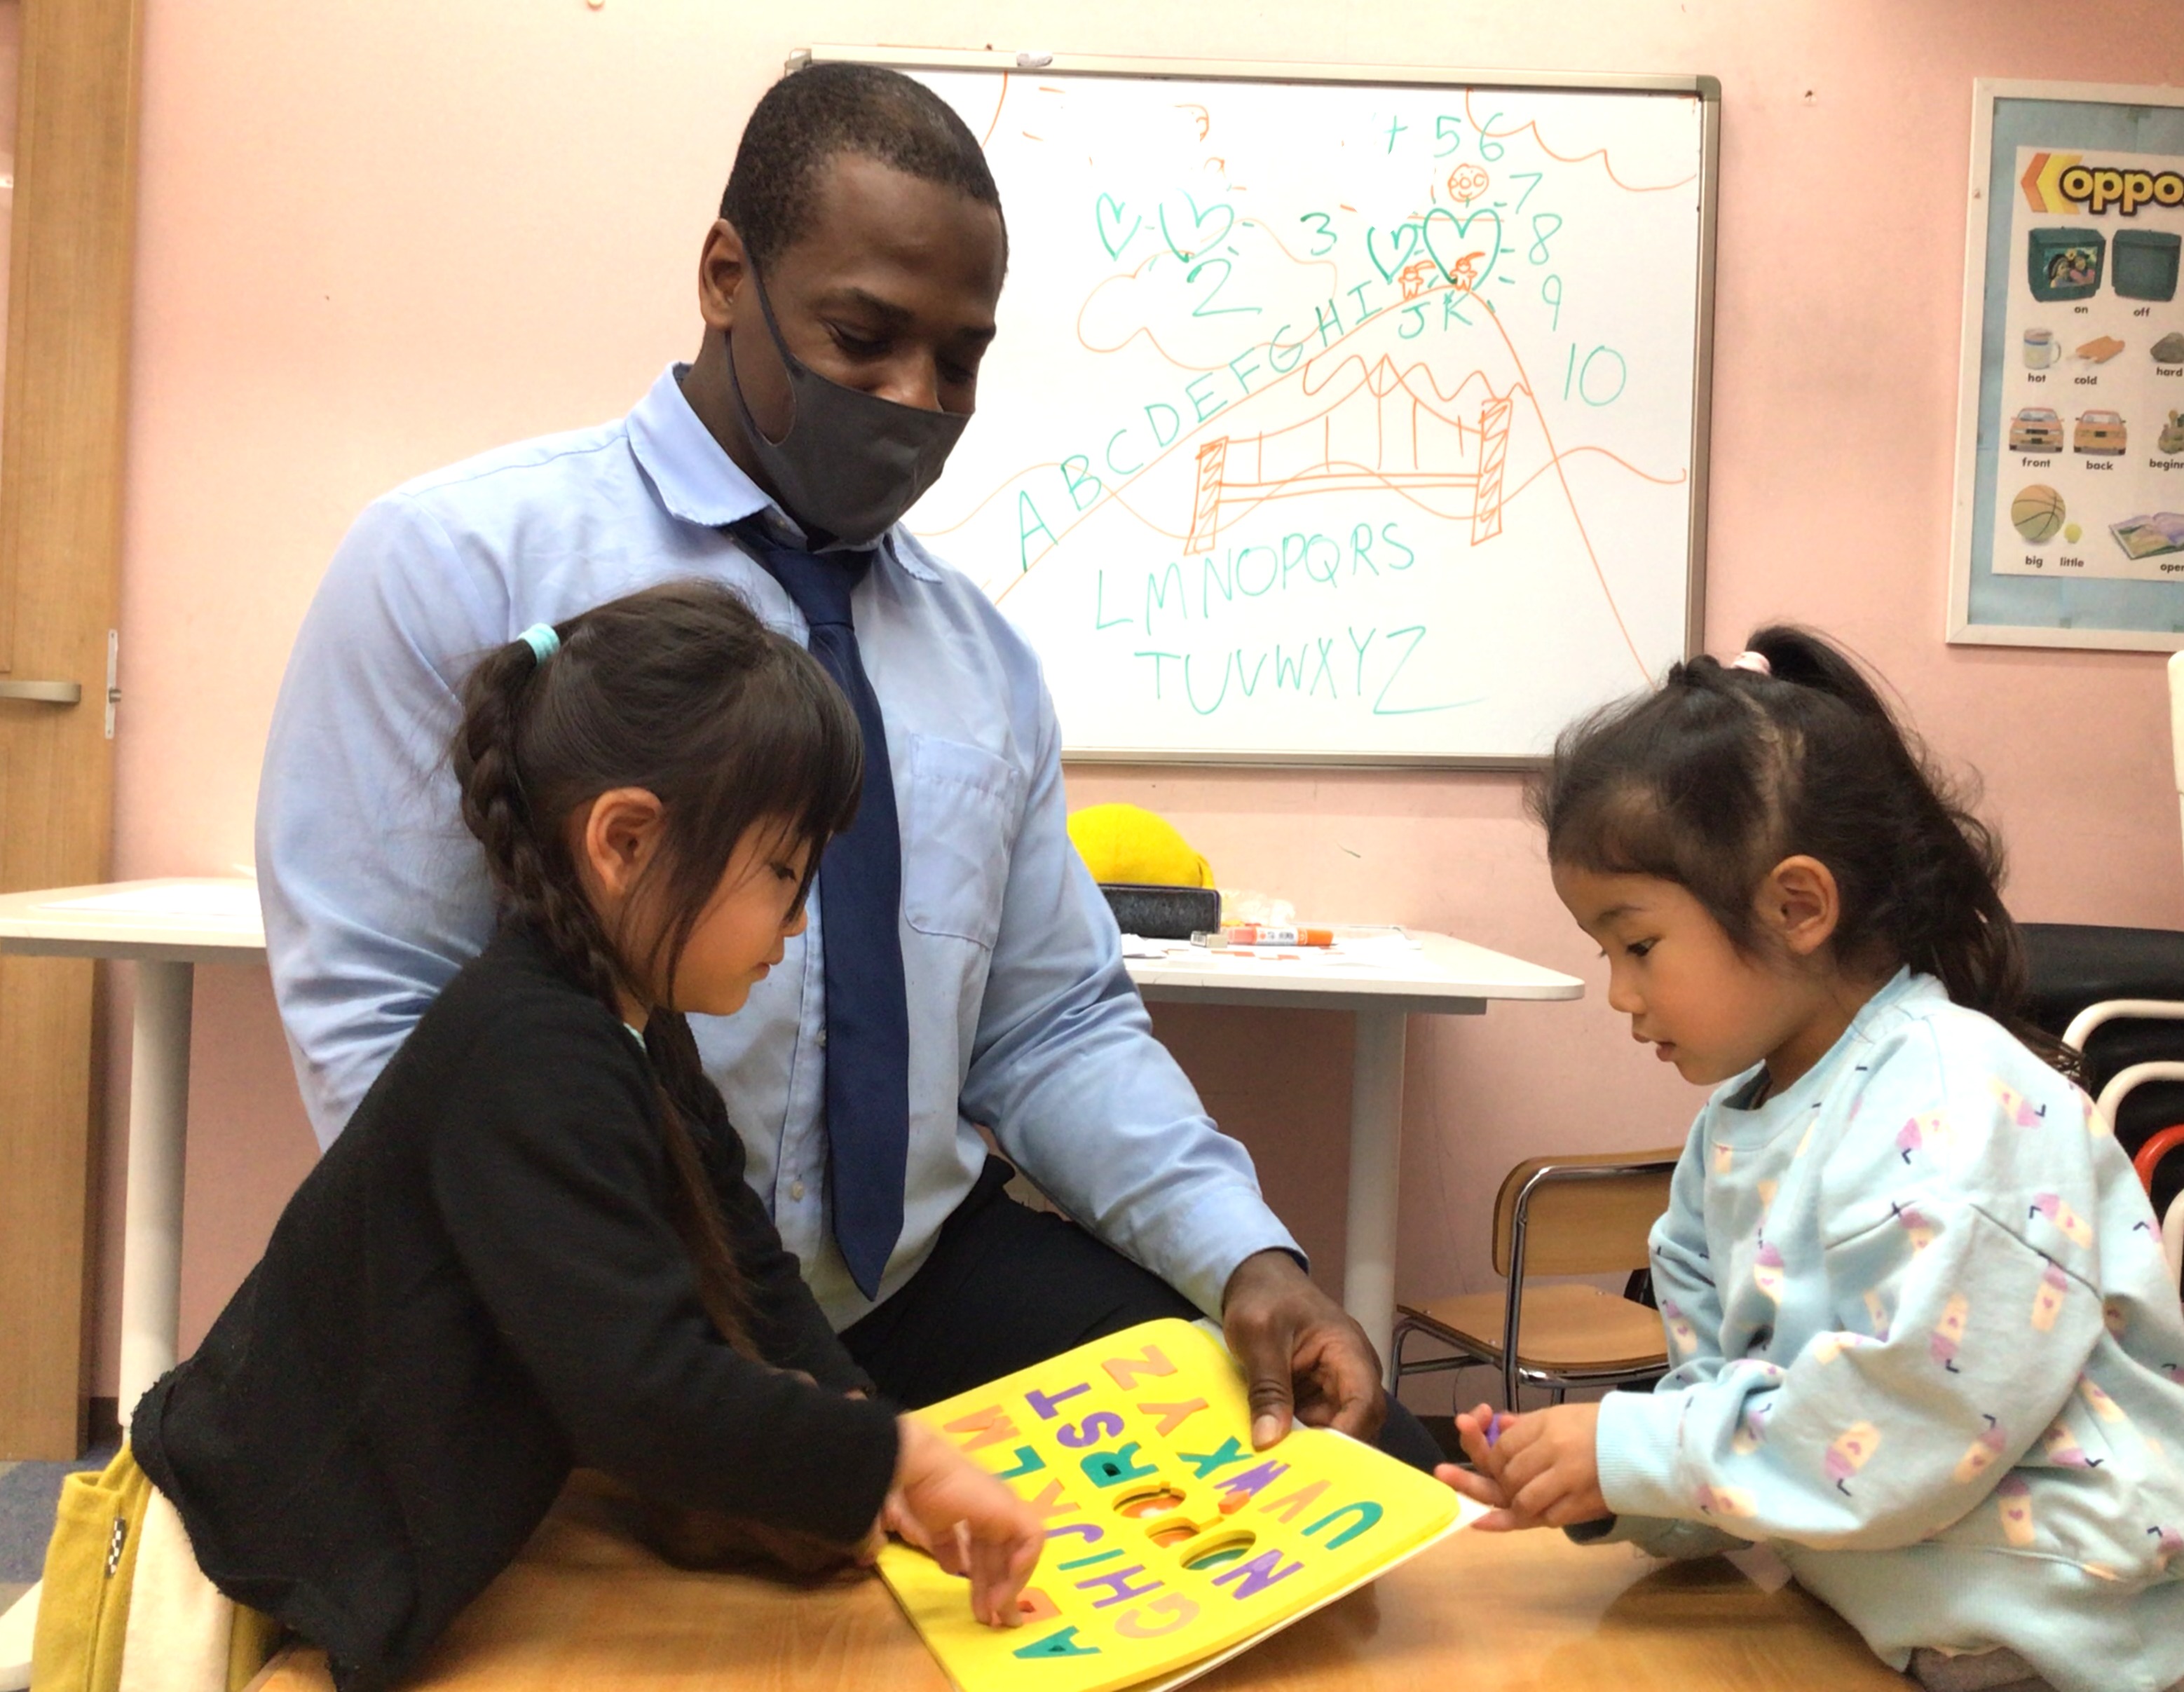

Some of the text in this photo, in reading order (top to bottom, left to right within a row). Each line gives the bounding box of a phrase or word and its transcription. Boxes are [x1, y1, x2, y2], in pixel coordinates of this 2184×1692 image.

[1433, 115, 1461, 158] 5
[1479, 113, 1503, 161] 6
[1510, 172, 1543, 214] 7
[1300, 212, 1337, 255] 3
[1529, 213, 1562, 265] 8
[1187, 259, 1262, 317] 2
[1542, 274, 1562, 332] 9
[2074, 305, 2150, 317] on off
[1564, 343, 1626, 407] 10
[2027, 367, 2183, 385] hot cold hard
[2021, 457, 2051, 468] front
[2086, 460, 2113, 470] back
[2025, 557, 2043, 568] big
[2059, 557, 2084, 567] little
